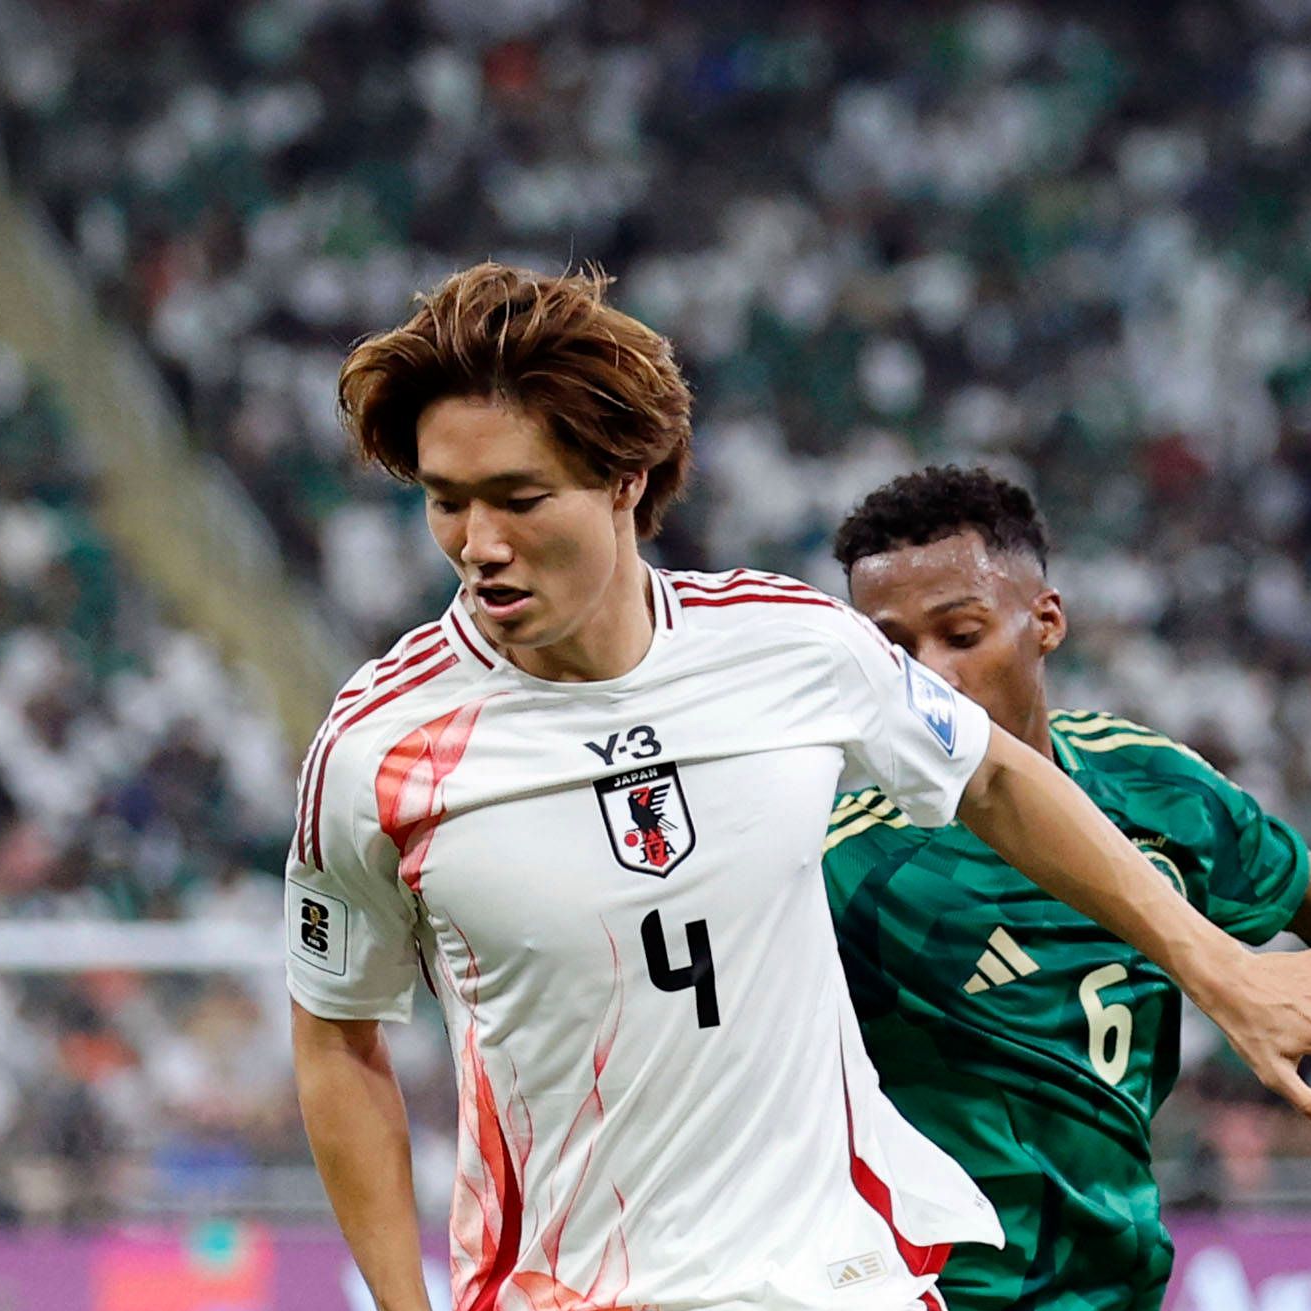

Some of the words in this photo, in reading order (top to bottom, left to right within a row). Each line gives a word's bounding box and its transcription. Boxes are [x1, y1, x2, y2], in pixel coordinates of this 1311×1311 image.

[583, 724, 663, 766] Y-3
[613, 767, 659, 788] JAPAN
[640, 909, 721, 1030] 4
[1078, 962, 1133, 1087] 6
